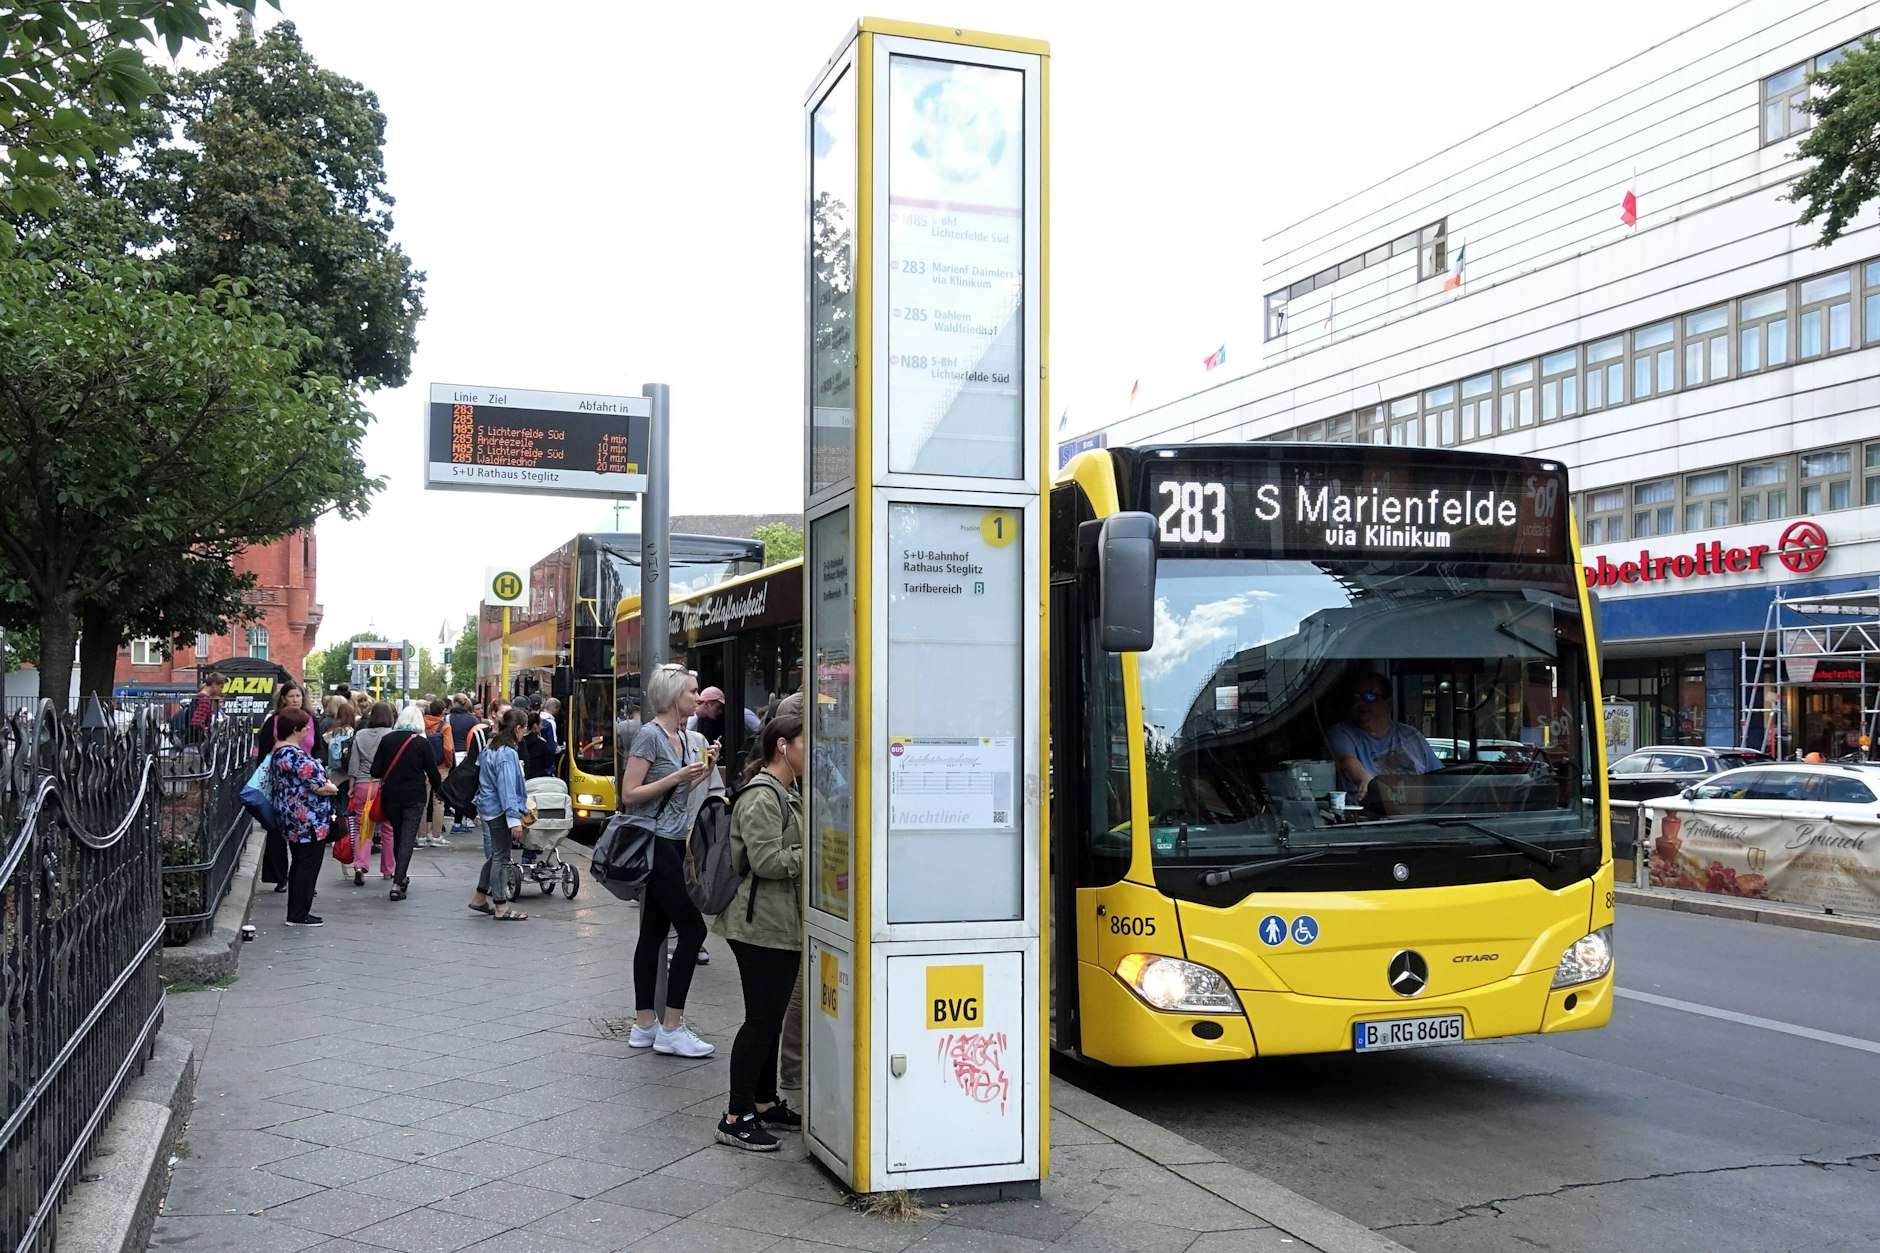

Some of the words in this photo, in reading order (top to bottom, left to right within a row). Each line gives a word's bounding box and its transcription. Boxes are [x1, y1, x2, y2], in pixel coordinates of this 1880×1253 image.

[931, 228, 989, 242] Lichterfelde
[902, 259, 926, 275] 283
[932, 276, 947, 285] via
[950, 276, 992, 289] Klinikum
[903, 307, 928, 322] 285
[934, 309, 971, 321] Dahlem
[934, 322, 998, 336] Waldfriedhof
[900, 354, 928, 369] N88
[931, 356, 958, 368] S-Bhf
[931, 368, 989, 383] Lichterfelde
[991, 372, 1010, 384] Süd
[453, 404, 474, 415] 283
[454, 391, 478, 403] Linie
[488, 394, 507, 405] Ziel
[579, 401, 616, 414] Abfahrt
[619, 405, 629, 414] in
[453, 415, 474, 424] 285
[452, 423, 474, 434] M85
[478, 425, 484, 435] S
[487, 426, 544, 439] Lichterfelde
[547, 429, 565, 440] Süd
[602, 434, 608, 442] 4
[610, 434, 627, 444] min
[453, 434, 473, 444] 285
[598, 443, 609, 452] 10
[610, 444, 627, 454] min
[452, 443, 473, 454] M85
[477, 444, 484, 454] S
[487, 445, 544, 458] Lichterfelde
[547, 448, 564, 459] Süd
[597, 453, 608, 462] 17
[610, 453, 626, 463] min
[452, 453, 472, 464] 285
[476, 455, 538, 467] Waldfriedhof
[596, 461, 608, 470] 20
[609, 463, 626, 472] min
[453, 466, 474, 477] S+U
[478, 468, 519, 480] Rathaus
[521, 470, 560, 482] Steglitz
[1158, 481, 1226, 543] 283
[1255, 484, 1281, 521] S
[1297, 485, 1517, 526] Marienfelde
[993, 516, 1003, 539] 1
[1325, 526, 1357, 546] via
[1365, 526, 1451, 548] Klinikum
[903, 550, 970, 562] S+U-Bahnhof
[903, 562, 944, 573] Rathaus
[946, 563, 983, 576] Steglitz
[500, 578, 515, 594] H
[904, 583, 962, 594] Tarifbereich
[975, 583, 983, 594] B
[704, 581, 768, 631] Schlaflosigkeit!
[899, 810, 970, 825] Nachtlinie
[1684, 818, 1747, 843] Frühstück
[1785, 823, 1867, 851] Brunch
[1110, 916, 1156, 936] 8605
[1452, 953, 1500, 963] CITARO
[822, 983, 837, 1011] BVG
[933, 998, 978, 1022] BVG
[1367, 1026, 1379, 1045] B
[1391, 1022, 1413, 1043] RG
[1417, 1019, 1460, 1041] 8605
